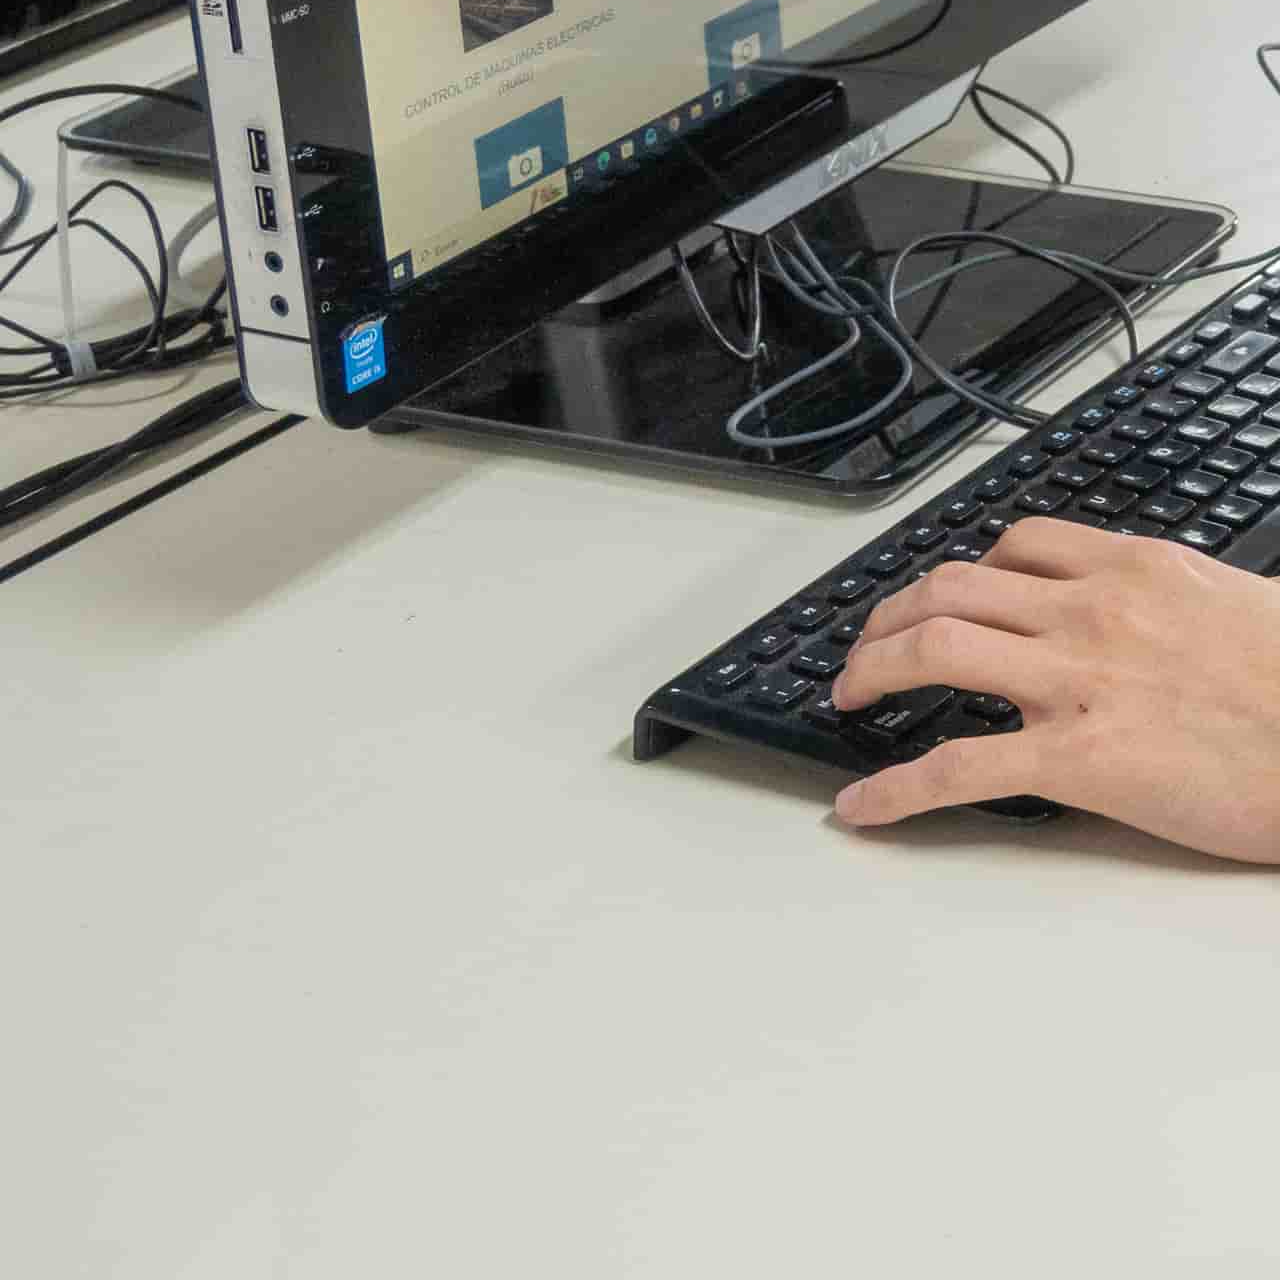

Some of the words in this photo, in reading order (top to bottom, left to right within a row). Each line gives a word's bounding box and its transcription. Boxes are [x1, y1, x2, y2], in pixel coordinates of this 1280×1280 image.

[403, 83, 463, 120] CONTROL
[464, 71, 482, 90] DE
[352, 332, 374, 352] intel
